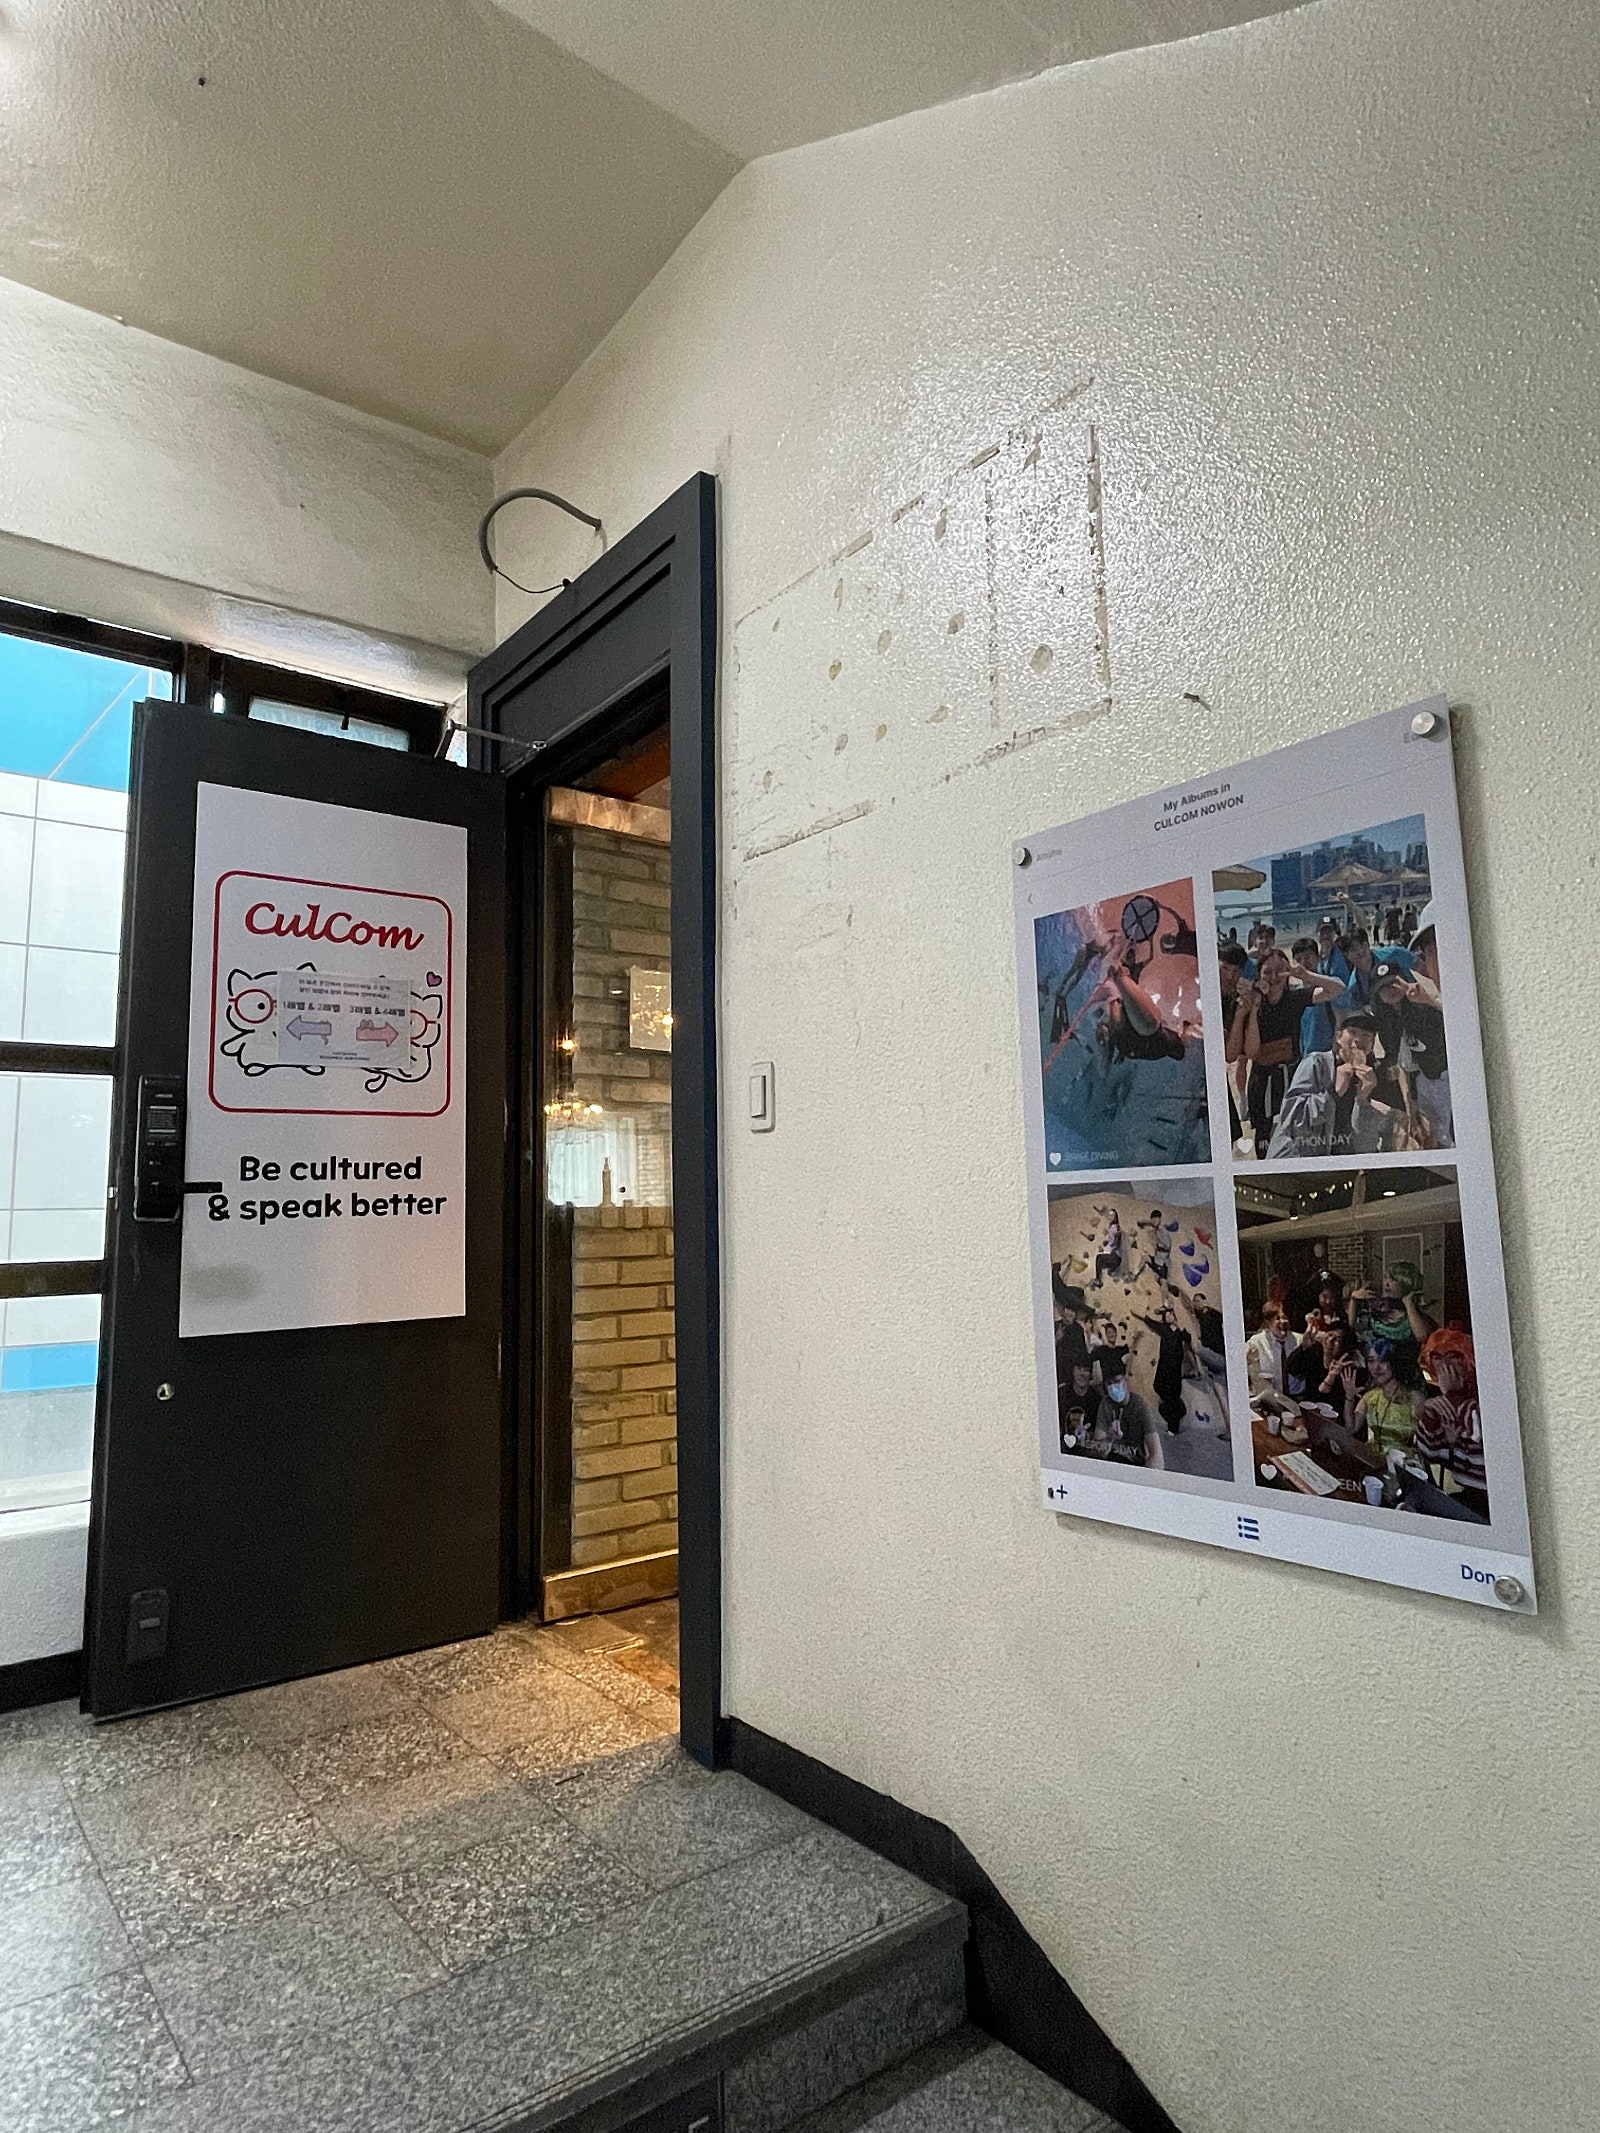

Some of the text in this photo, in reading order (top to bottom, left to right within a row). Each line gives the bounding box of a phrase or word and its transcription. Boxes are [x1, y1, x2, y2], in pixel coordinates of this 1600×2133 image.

[1163, 783, 1231, 812] My Albums in
[1153, 794, 1244, 831] CULCOM NOWON
[244, 902, 425, 951] CulCom
[1329, 1132, 1353, 1146] DAY
[240, 1155, 422, 1181] Be cultured
[208, 1192, 448, 1225] & speak better
[1460, 1564, 1496, 1584] Don
